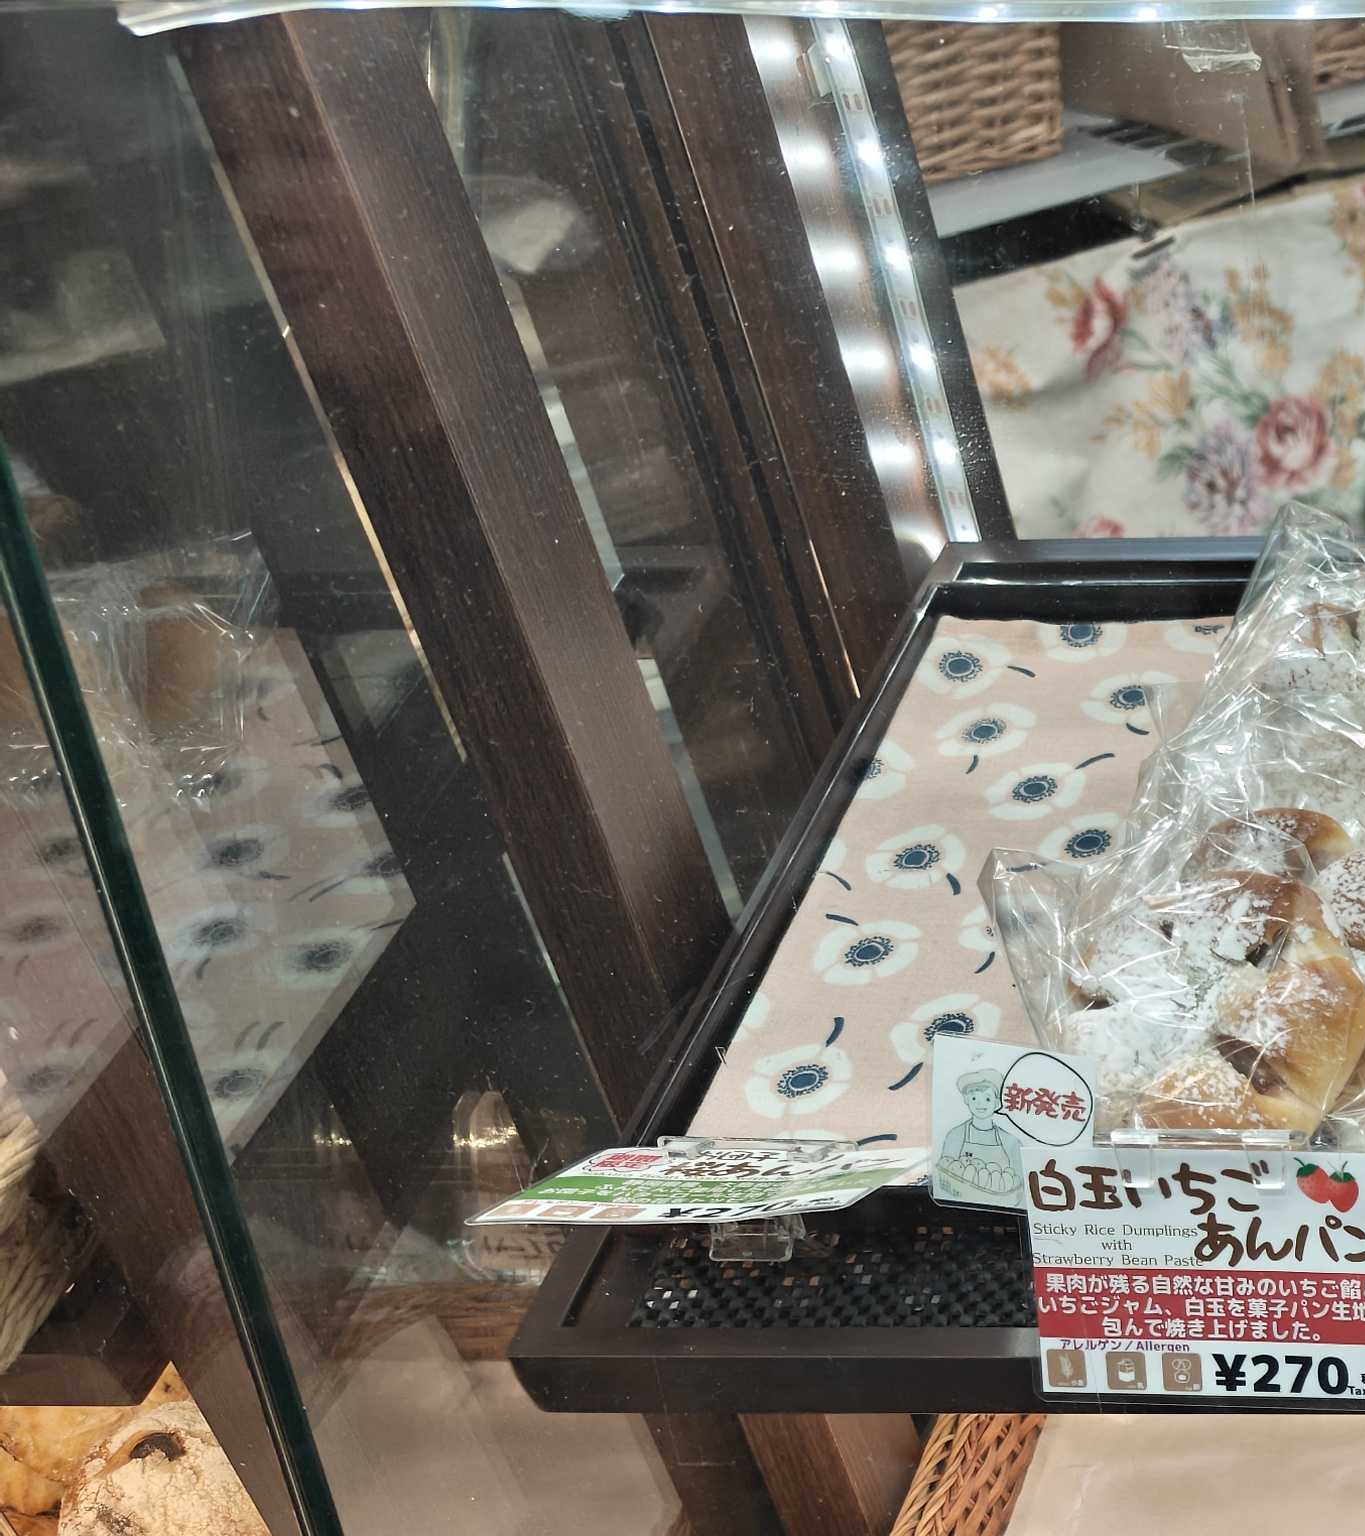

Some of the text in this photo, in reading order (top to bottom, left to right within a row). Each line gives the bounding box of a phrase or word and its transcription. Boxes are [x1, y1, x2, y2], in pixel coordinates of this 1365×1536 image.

[1004, 1082, 1086, 1122] 新発売
[1028, 1159, 1268, 1215] 白玉いちご
[1033, 1222, 1198, 1239] Sticky Rice Dumplings
[1102, 1240, 1132, 1251] with
[1032, 1253, 1203, 1268] Strawberry Bean Paste
[1102, 1318, 1322, 1342] 包んで焼き上げました。
[1212, 1353, 1349, 1396] ¥270
